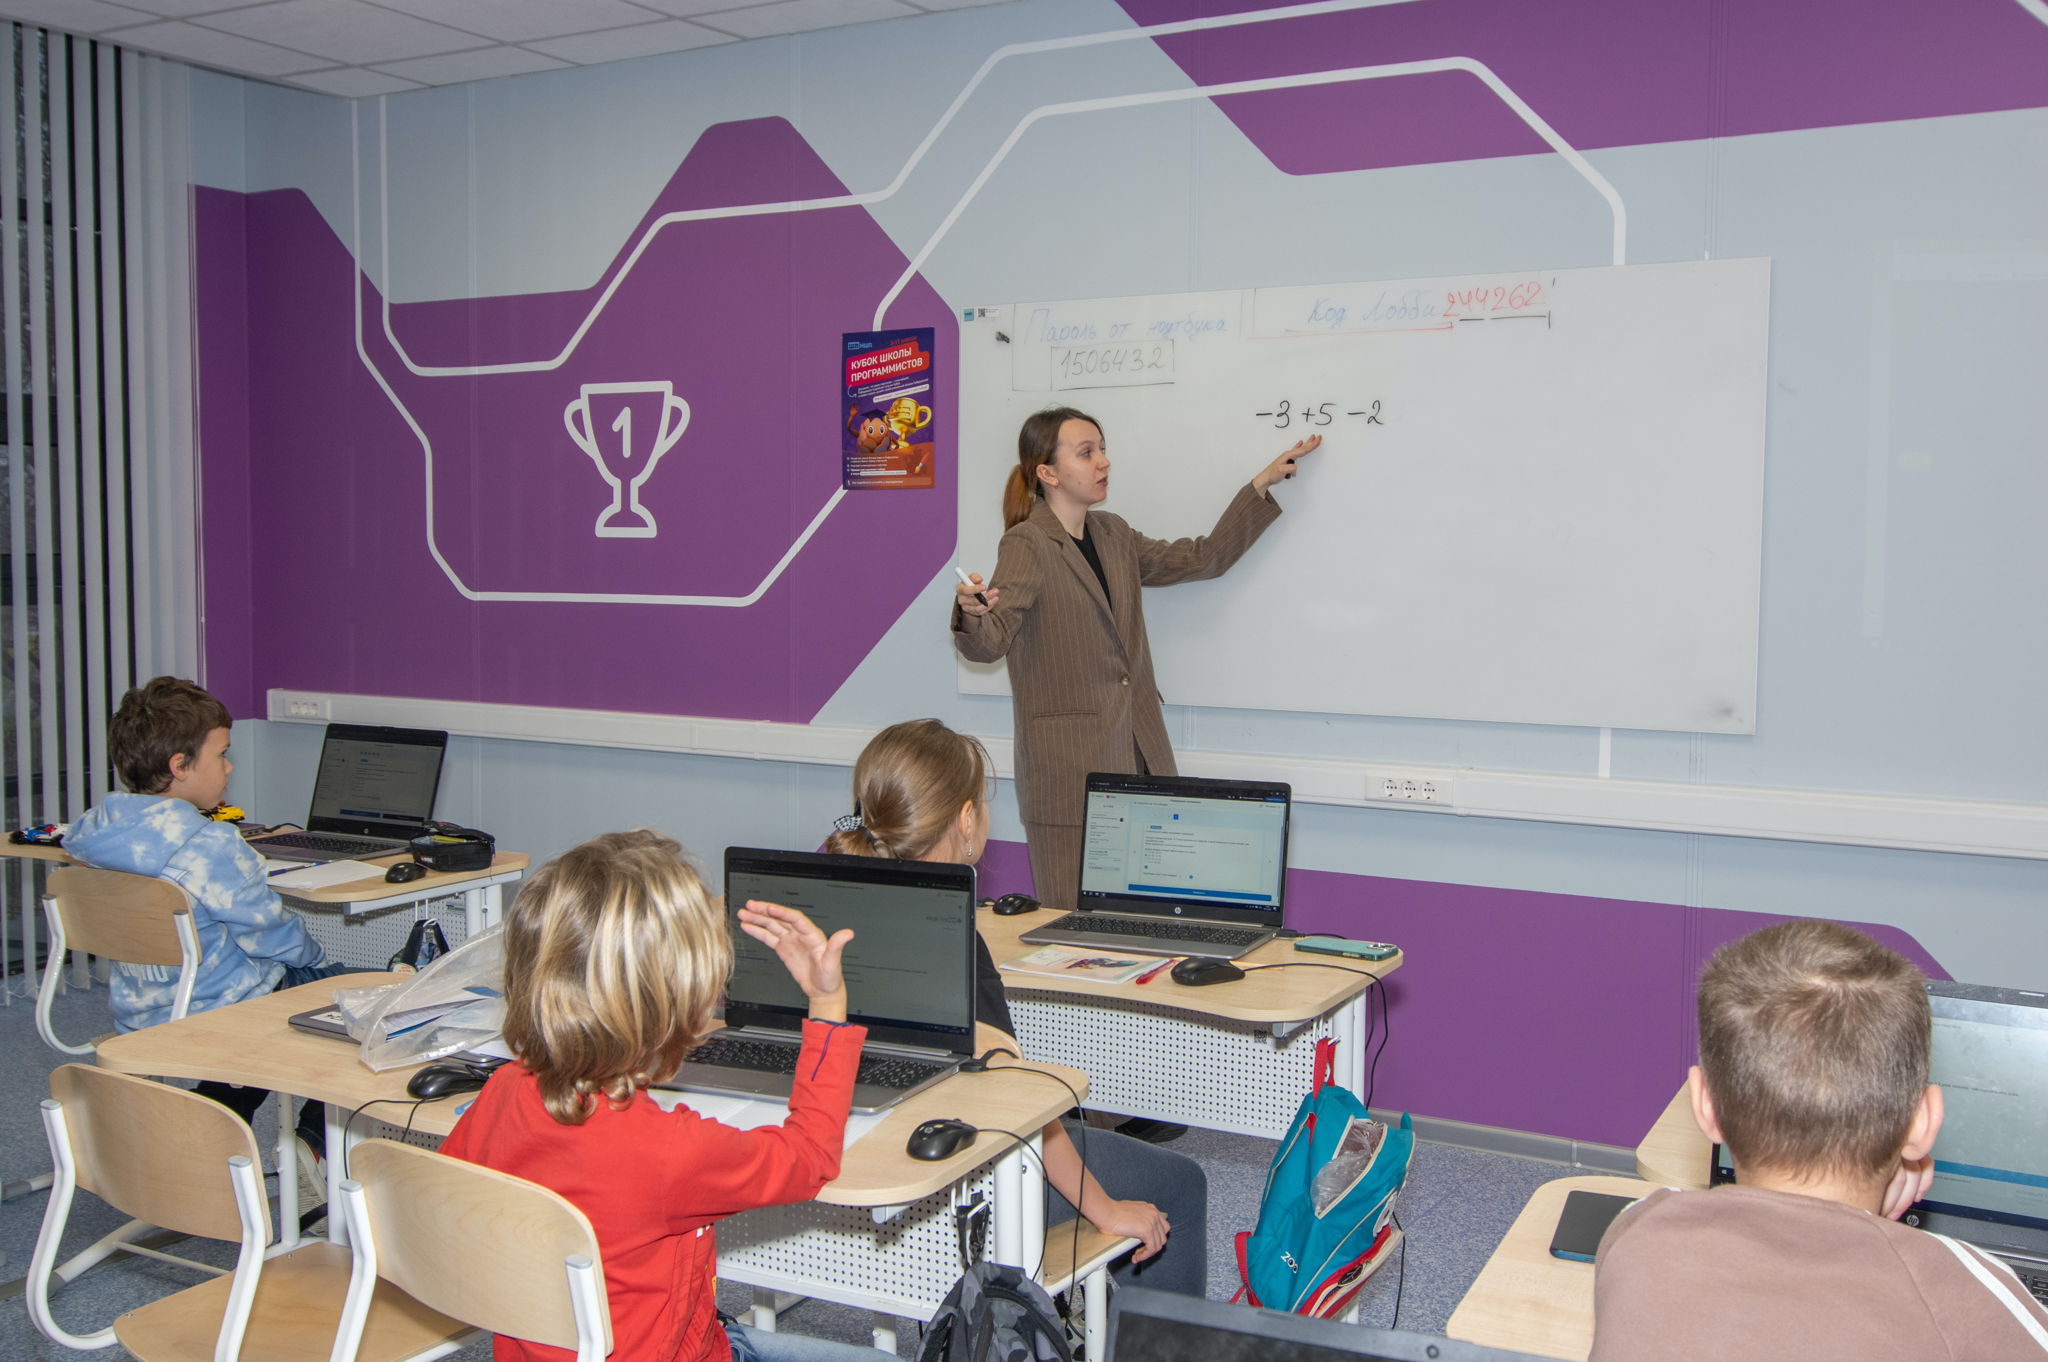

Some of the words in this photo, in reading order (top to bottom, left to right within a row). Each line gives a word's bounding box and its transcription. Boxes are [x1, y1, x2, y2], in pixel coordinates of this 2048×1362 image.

[1308, 297, 1348, 329] Код
[1442, 281, 1547, 317] 244262
[1024, 308, 1097, 345] Пароль
[1109, 322, 1133, 338] от
[1149, 310, 1228, 343] ноутбука
[850, 357, 923, 383] ПРОГРАММИСТОВ
[851, 355, 878, 370] КУБОК
[880, 347, 912, 363] ШКОЛЫ
[1060, 346, 1164, 379] 1506432
[611, 406, 631, 459] 1
